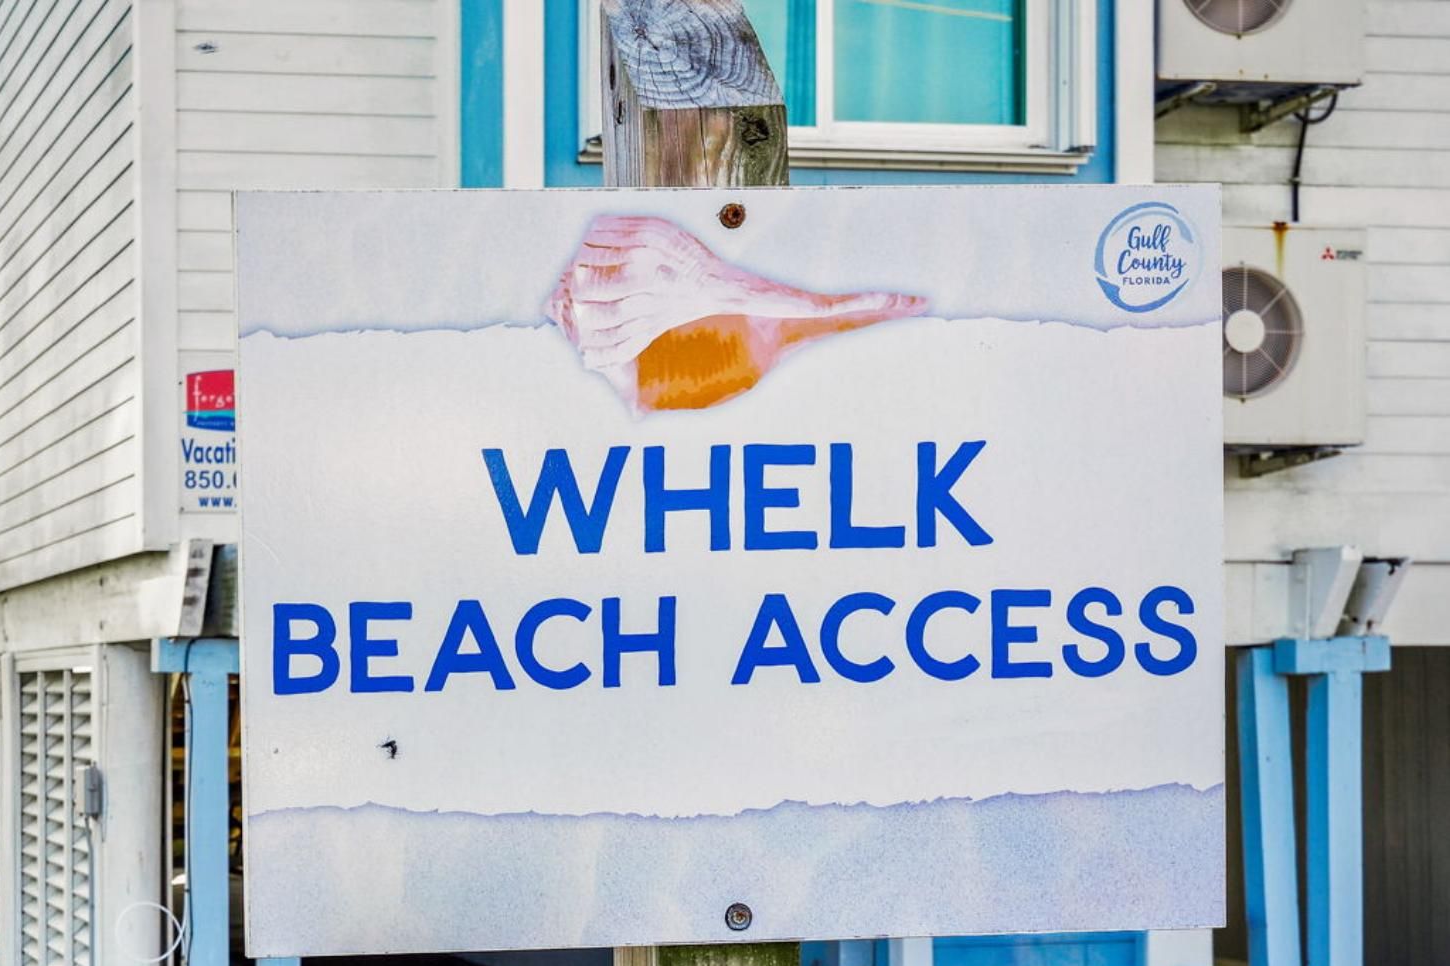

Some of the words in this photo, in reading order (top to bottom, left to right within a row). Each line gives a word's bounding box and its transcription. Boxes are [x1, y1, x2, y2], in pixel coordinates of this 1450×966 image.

[1128, 224, 1171, 252] Gulf
[1118, 250, 1186, 278] County
[1123, 277, 1170, 285] FLORIDA
[482, 440, 994, 556] WHELK
[272, 595, 678, 696] BEACH
[731, 586, 1198, 686] ACCESS
